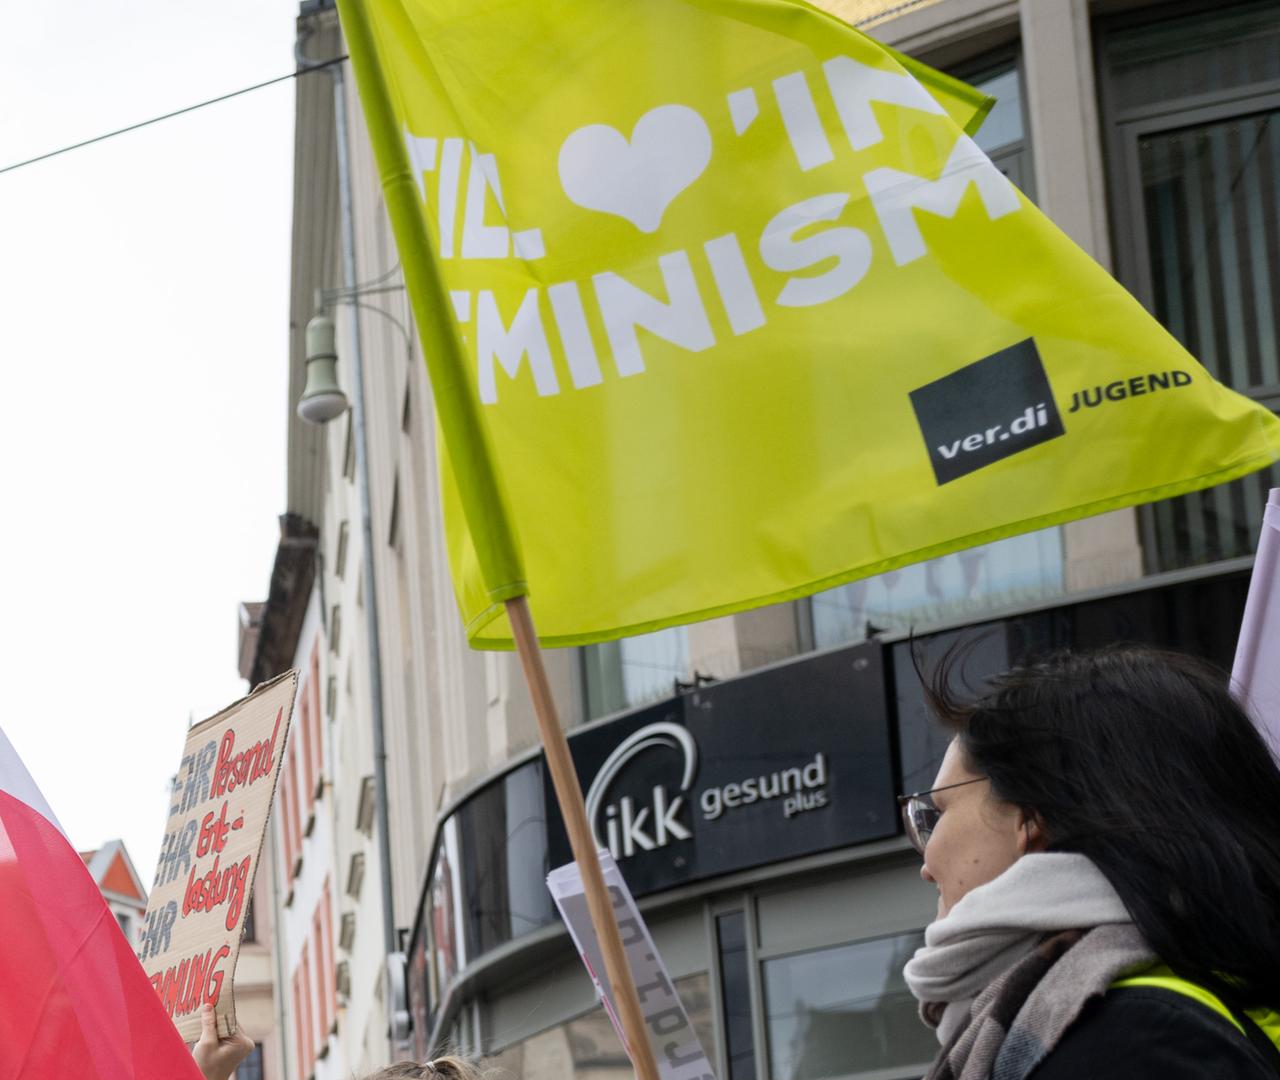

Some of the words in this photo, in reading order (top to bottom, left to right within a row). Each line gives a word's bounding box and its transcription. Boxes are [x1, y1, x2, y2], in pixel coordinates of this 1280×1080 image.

[1068, 370, 1193, 413] JUGEND
[938, 403, 1048, 459] ver.di
[605, 784, 693, 861] ikk
[699, 752, 827, 820] gesund
[783, 787, 828, 818] plus
